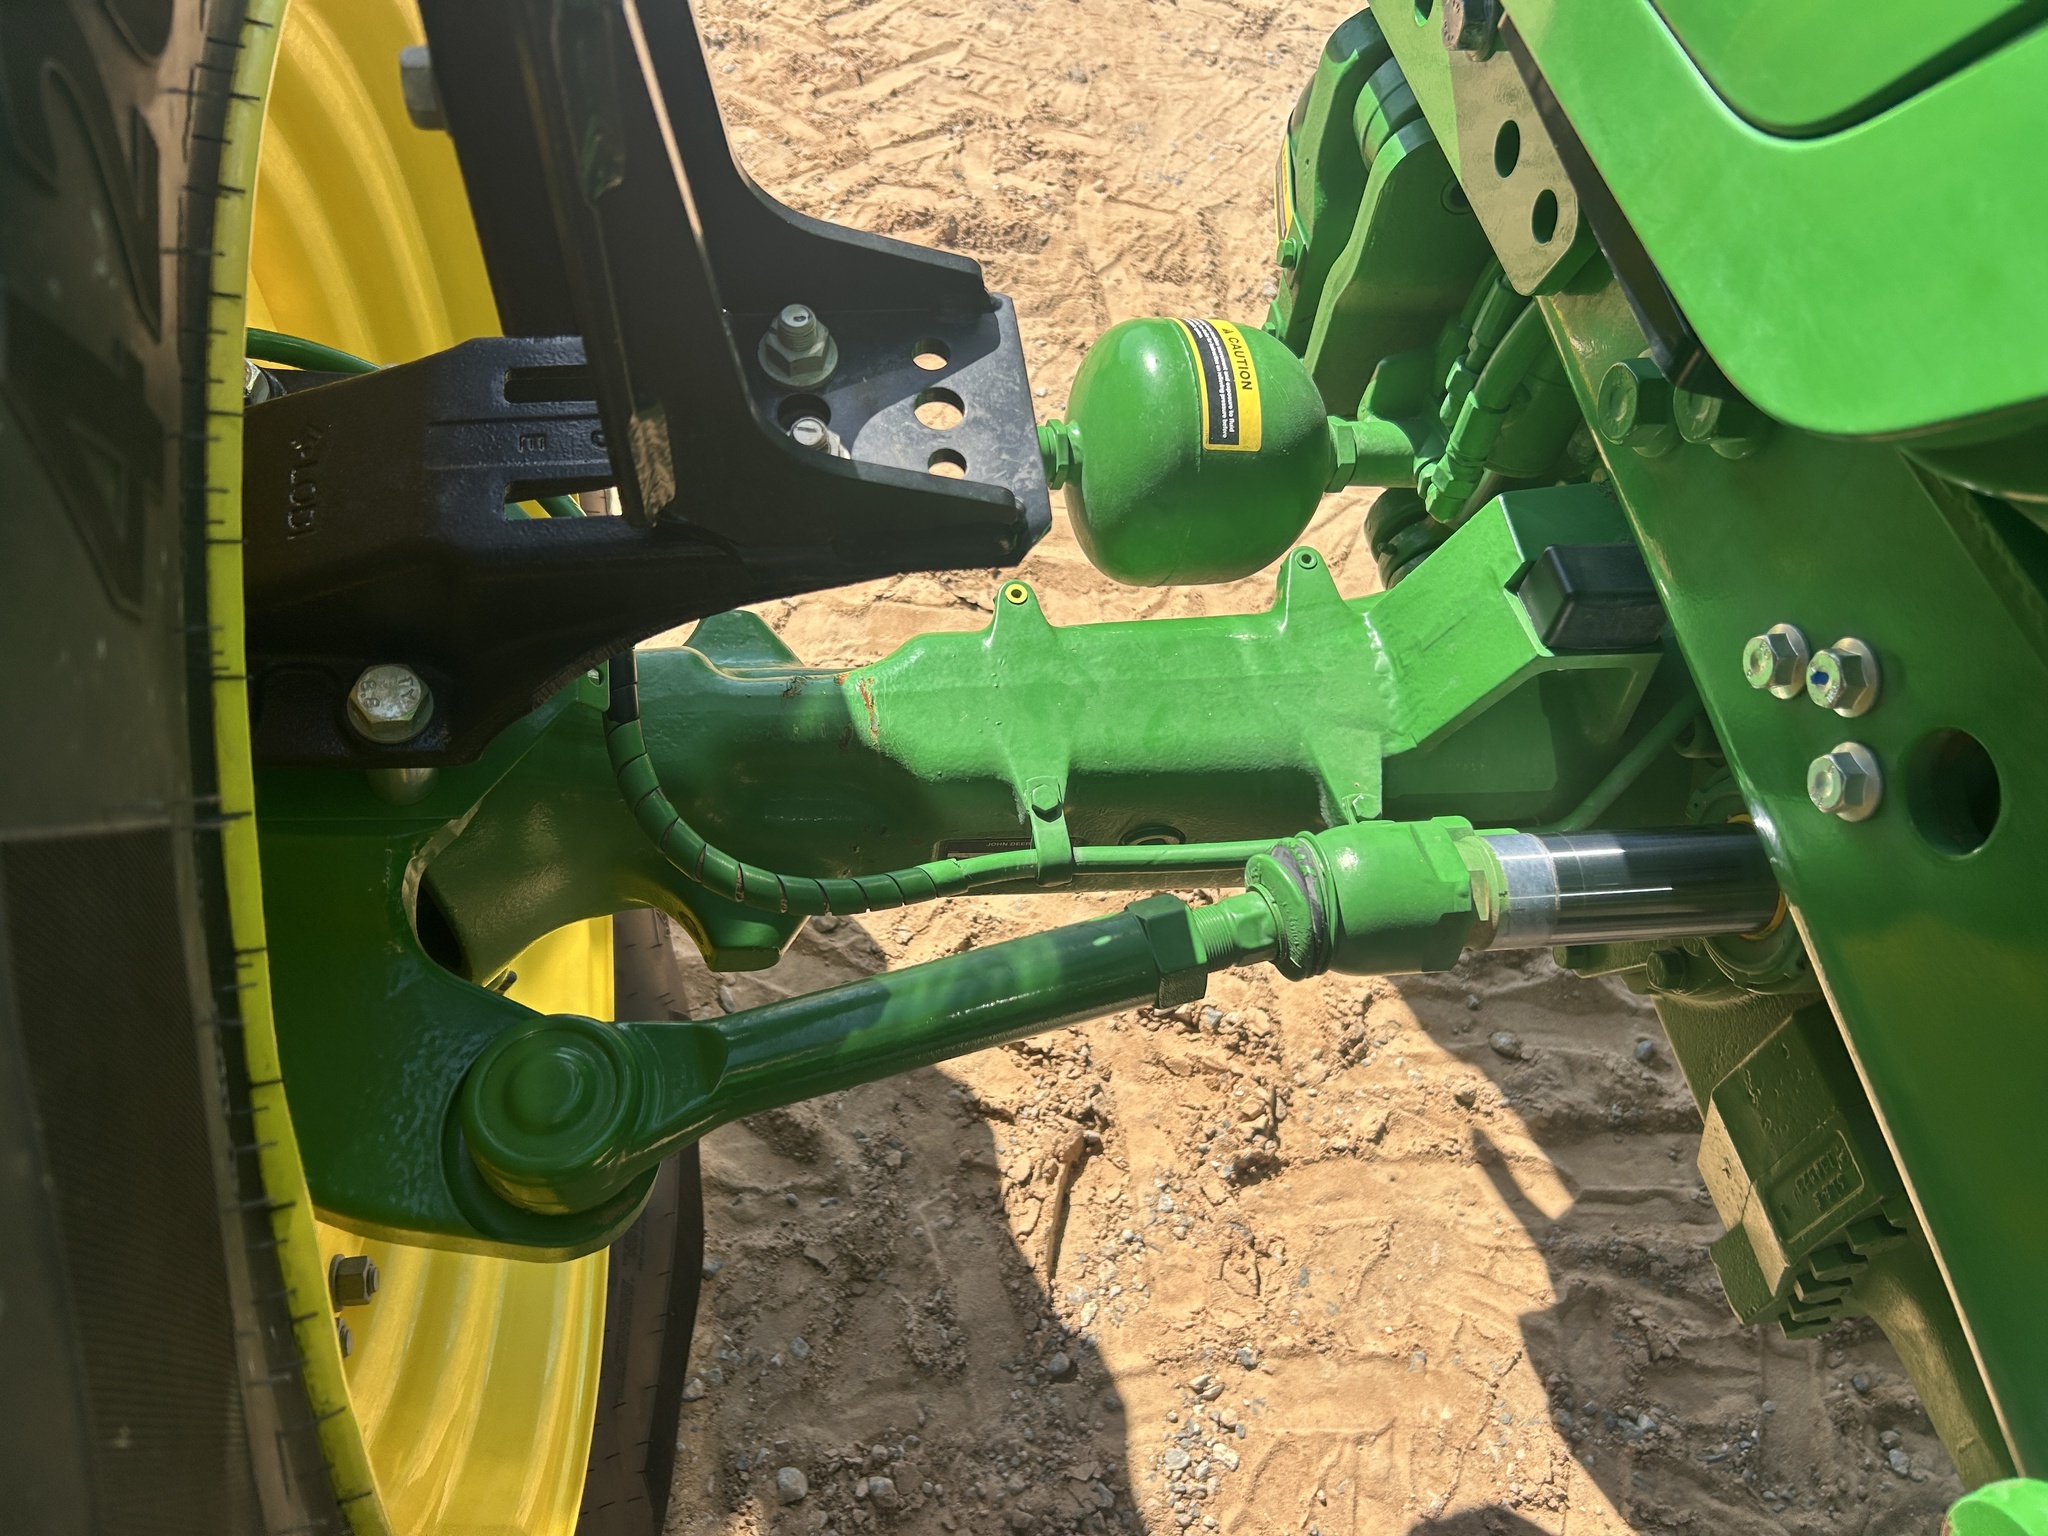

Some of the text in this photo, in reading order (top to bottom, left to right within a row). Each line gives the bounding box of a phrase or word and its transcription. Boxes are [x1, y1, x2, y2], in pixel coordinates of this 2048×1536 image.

[1223, 371, 1231, 382] and
[1228, 337, 1253, 390] CAUTION
[1217, 372, 1225, 394] relieving
[1225, 382, 1234, 410] exposure
[1219, 394, 1227, 419] pressure
[360, 680, 381, 708] 8.8
